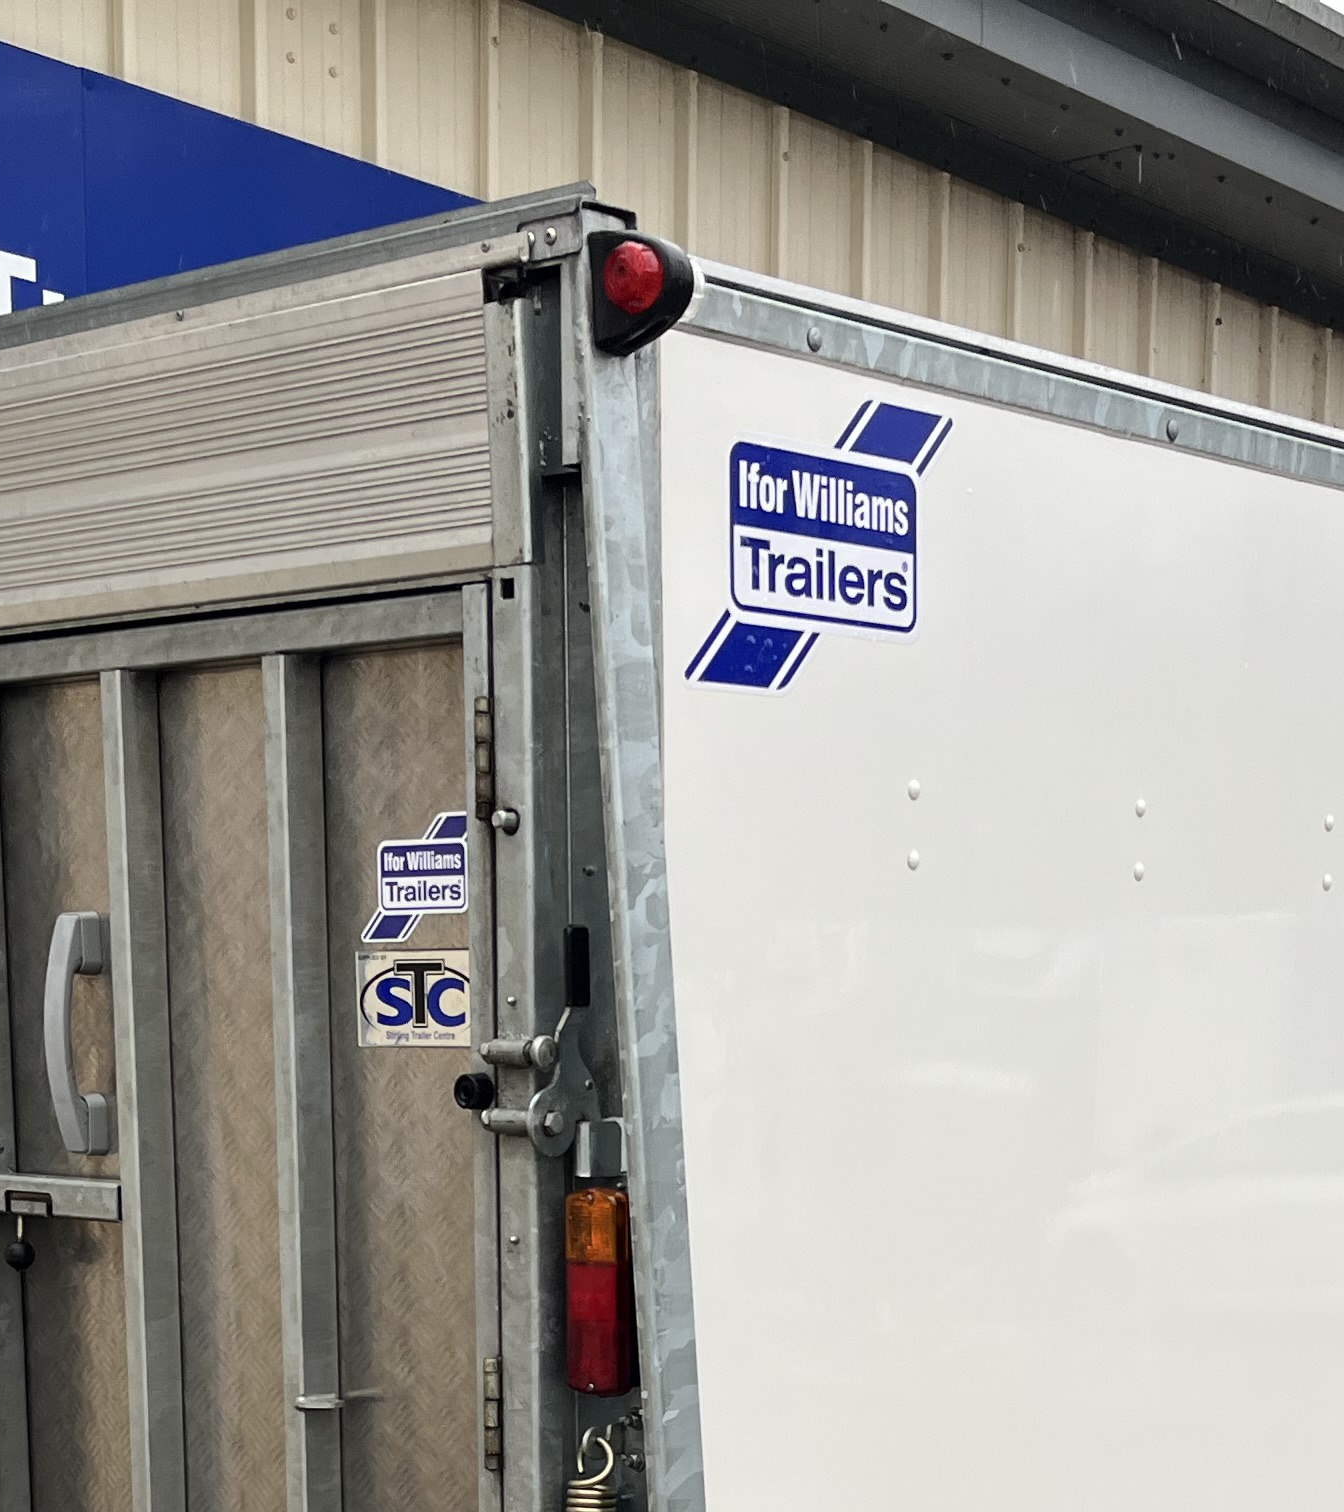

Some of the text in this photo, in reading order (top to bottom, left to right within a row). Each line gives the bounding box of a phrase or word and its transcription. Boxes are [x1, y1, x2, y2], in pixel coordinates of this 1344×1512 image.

[738, 459, 909, 536] Ifor Williams
[740, 535, 908, 611] Trailers
[383, 850, 462, 872] Ifor Williams
[385, 880, 461, 902] Trailers
[376, 959, 466, 1028] STC
